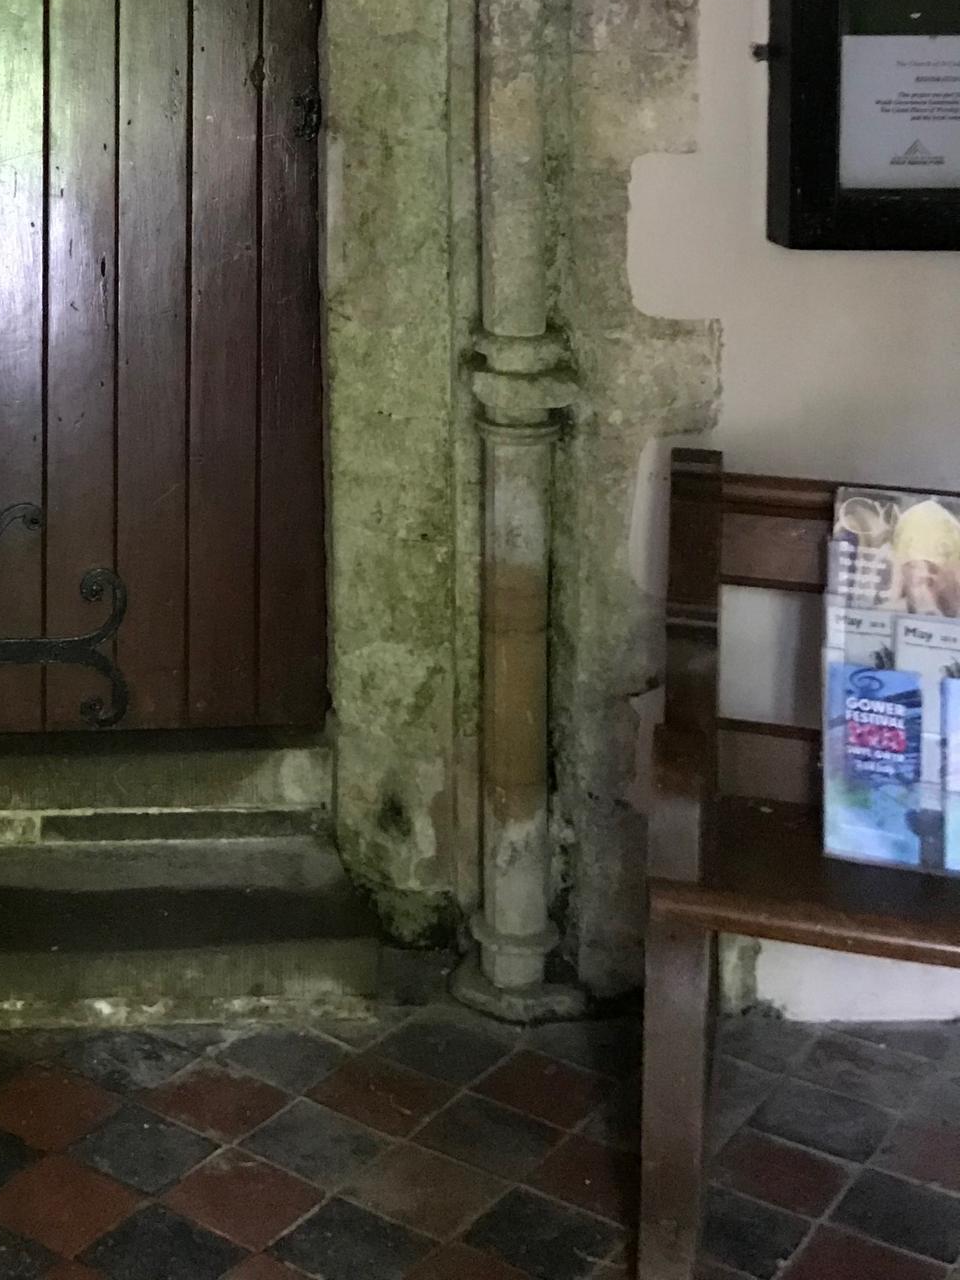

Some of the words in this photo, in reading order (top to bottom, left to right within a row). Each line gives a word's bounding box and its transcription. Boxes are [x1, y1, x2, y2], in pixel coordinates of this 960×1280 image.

[904, 626, 933, 642] May
[846, 697, 906, 717] GOWER
[845, 710, 905, 730] FESTIVAL
